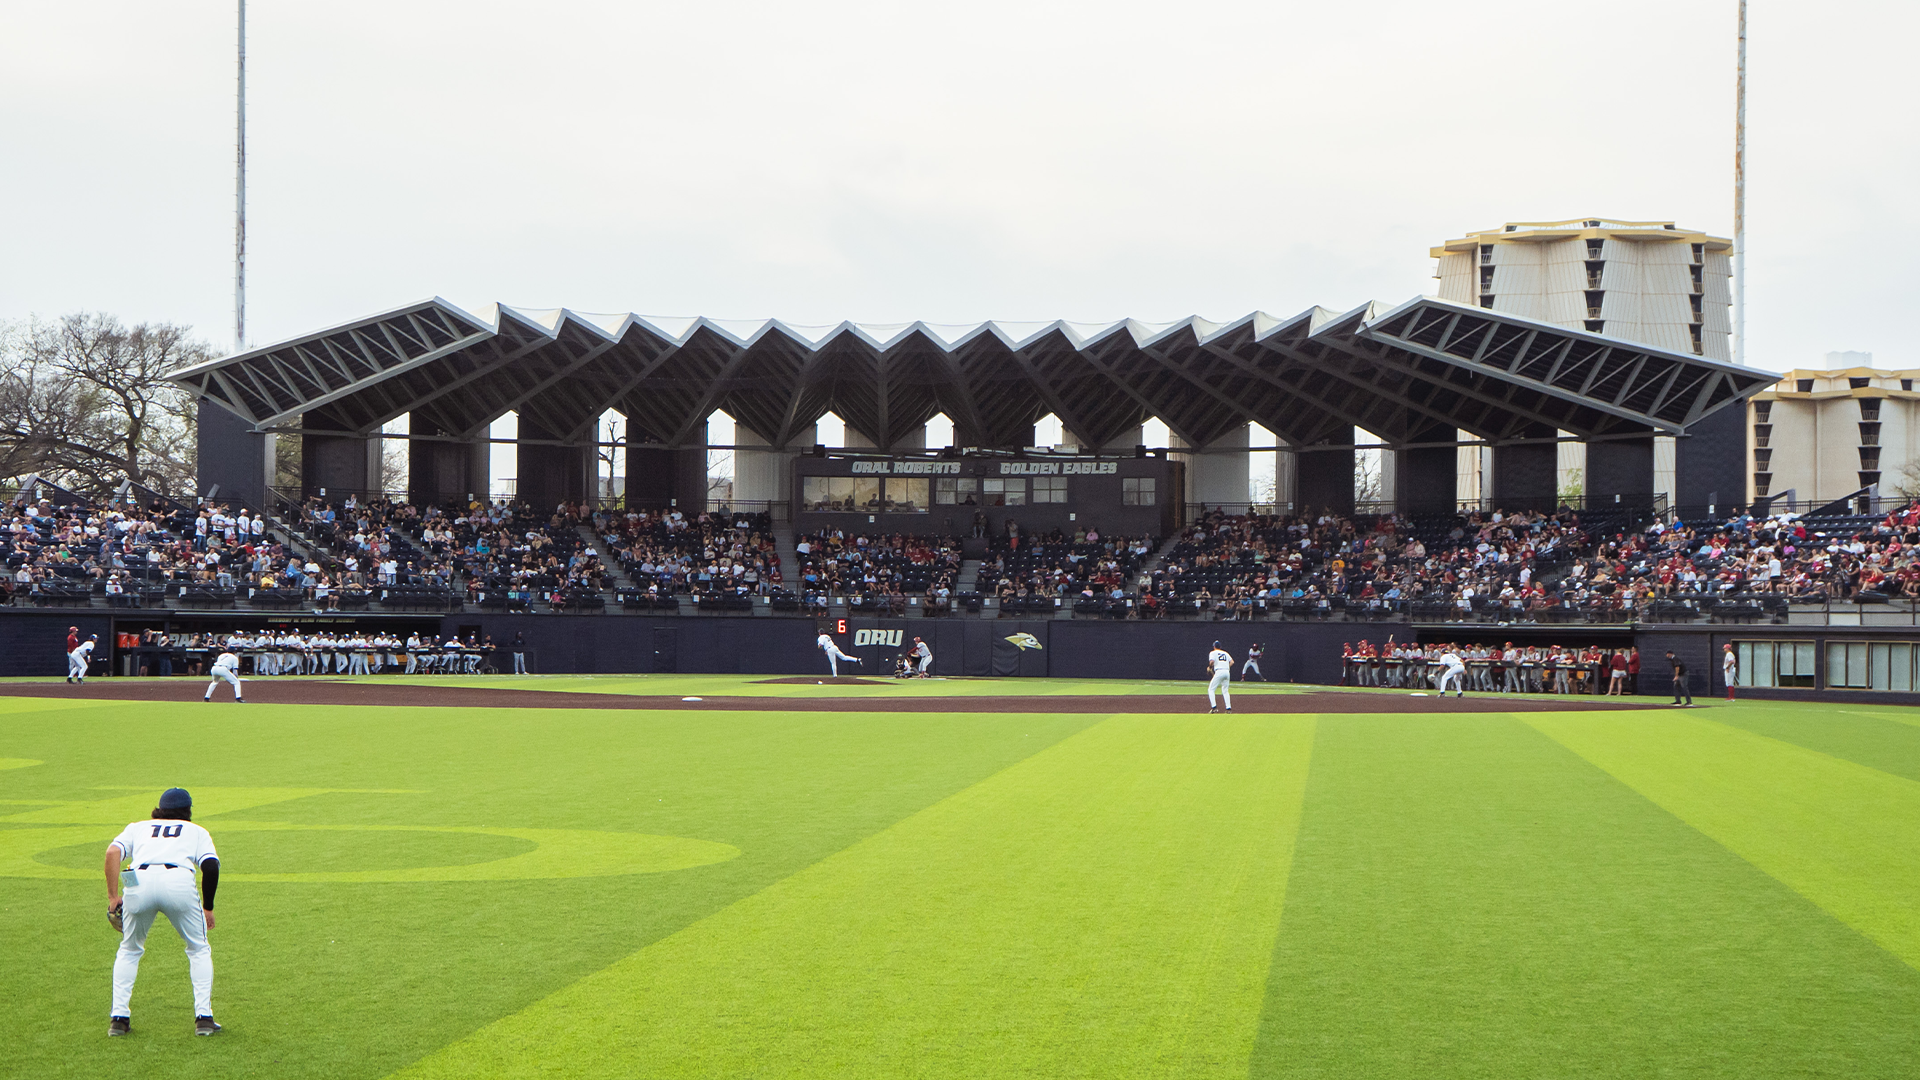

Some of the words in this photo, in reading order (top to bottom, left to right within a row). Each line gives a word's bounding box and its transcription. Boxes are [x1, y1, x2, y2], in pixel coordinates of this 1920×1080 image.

[851, 461, 890, 473] ORAL
[893, 461, 961, 474] ROBERTS
[1000, 462, 1060, 474] GOLDEN
[1062, 462, 1117, 474] EAGLES
[838, 619, 846, 633] 6
[854, 629, 904, 647] ORU
[151, 824, 184, 838] 10
